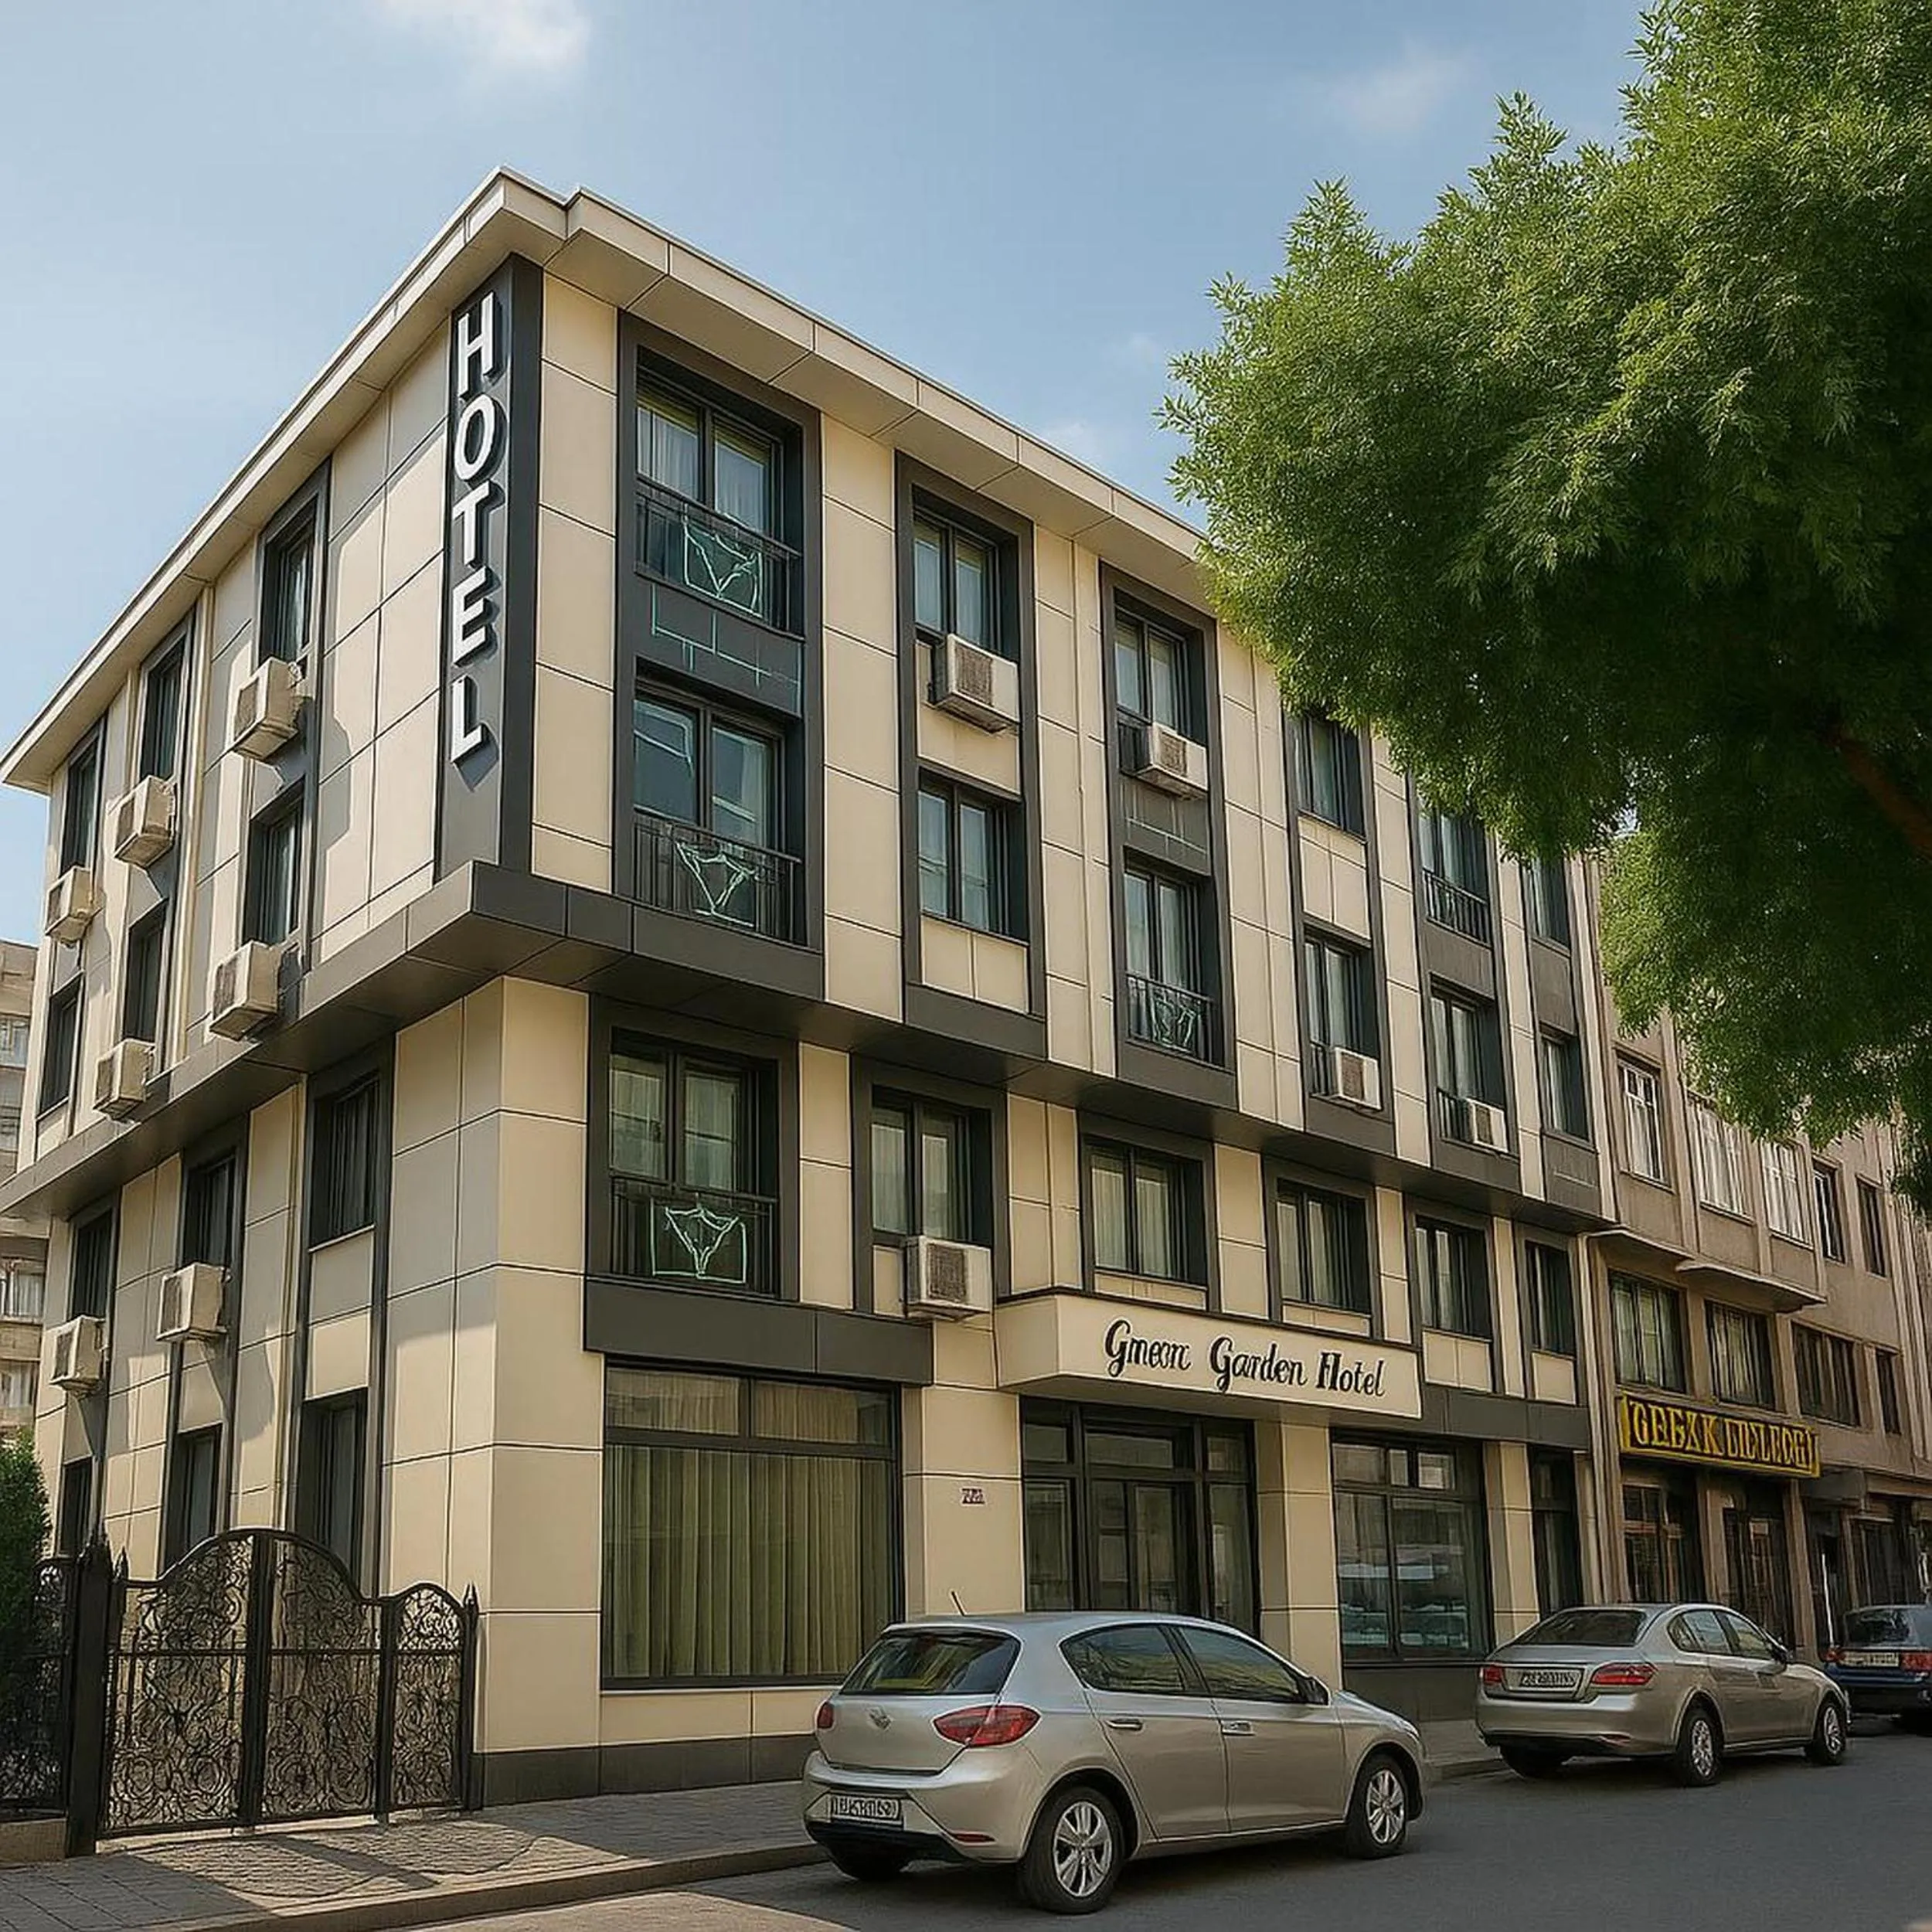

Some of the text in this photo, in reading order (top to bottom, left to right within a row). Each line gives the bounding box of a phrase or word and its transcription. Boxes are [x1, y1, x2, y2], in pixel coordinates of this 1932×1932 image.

[451, 291, 498, 765] HOTEL
[1209, 1336, 1308, 1392] Garden
[1315, 1351, 1385, 1396] Hotel
